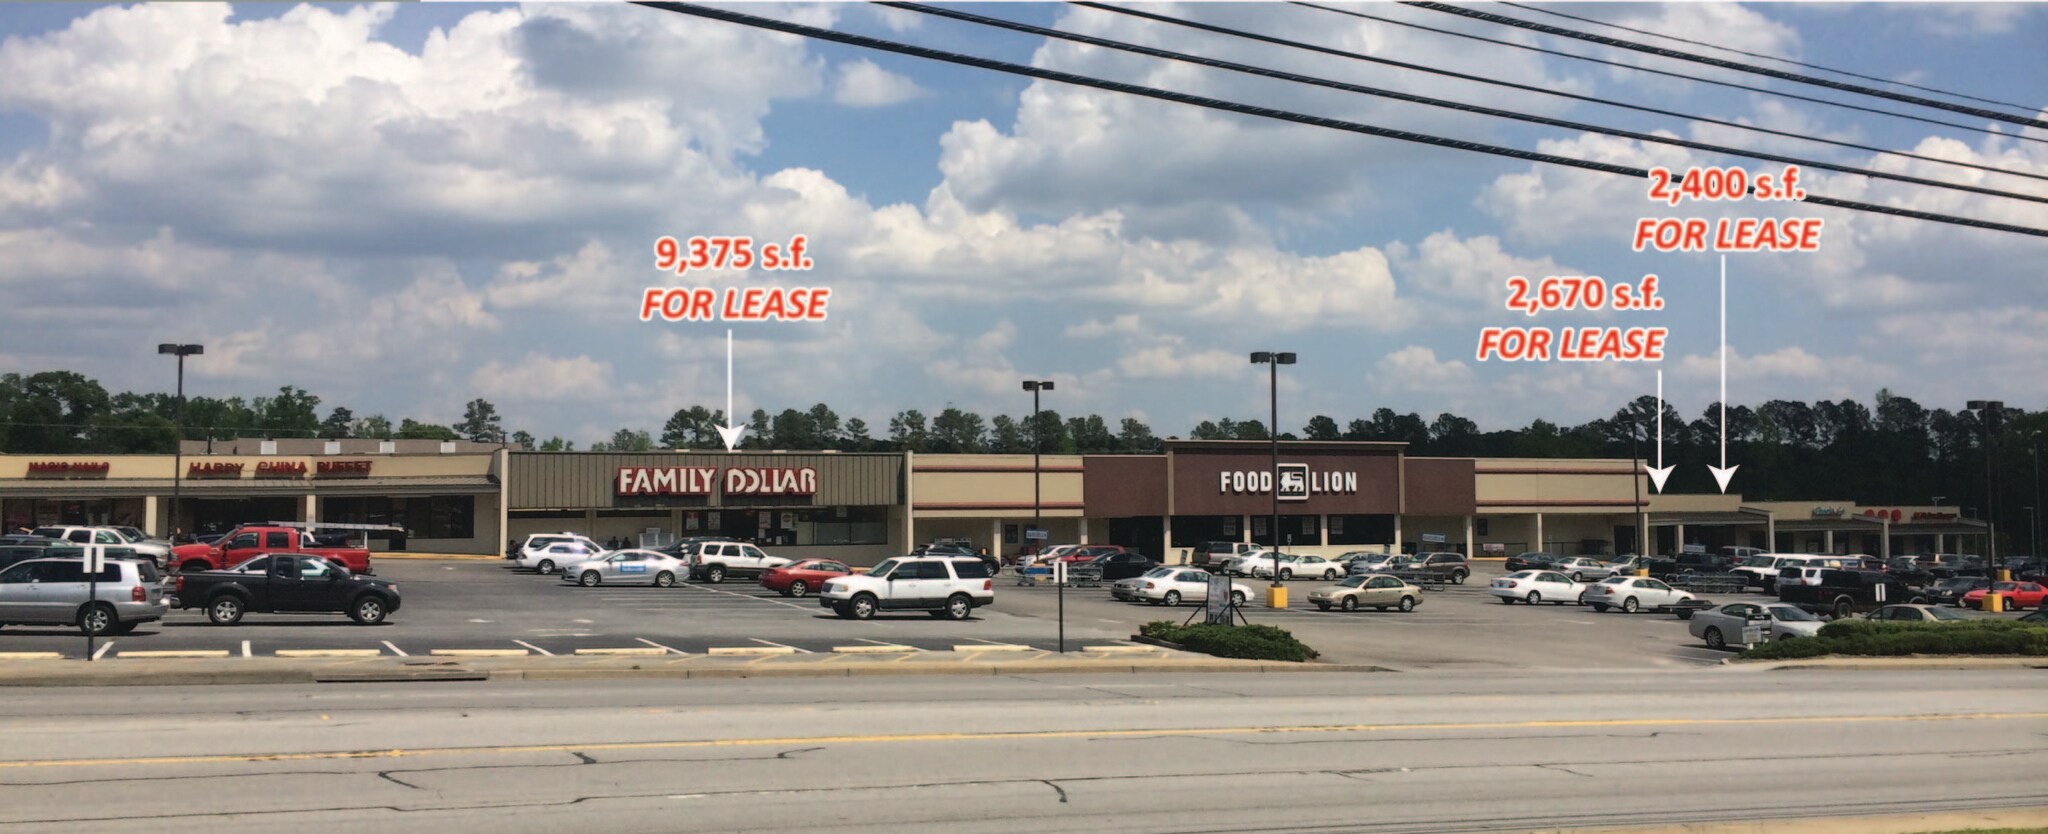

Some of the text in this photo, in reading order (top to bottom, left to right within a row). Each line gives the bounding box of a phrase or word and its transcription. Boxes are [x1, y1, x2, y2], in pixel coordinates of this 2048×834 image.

[257, 461, 308, 475] CHINA
[618, 467, 817, 494] FAMILY DOLLAR
[1219, 470, 1358, 493] FOOD LION
